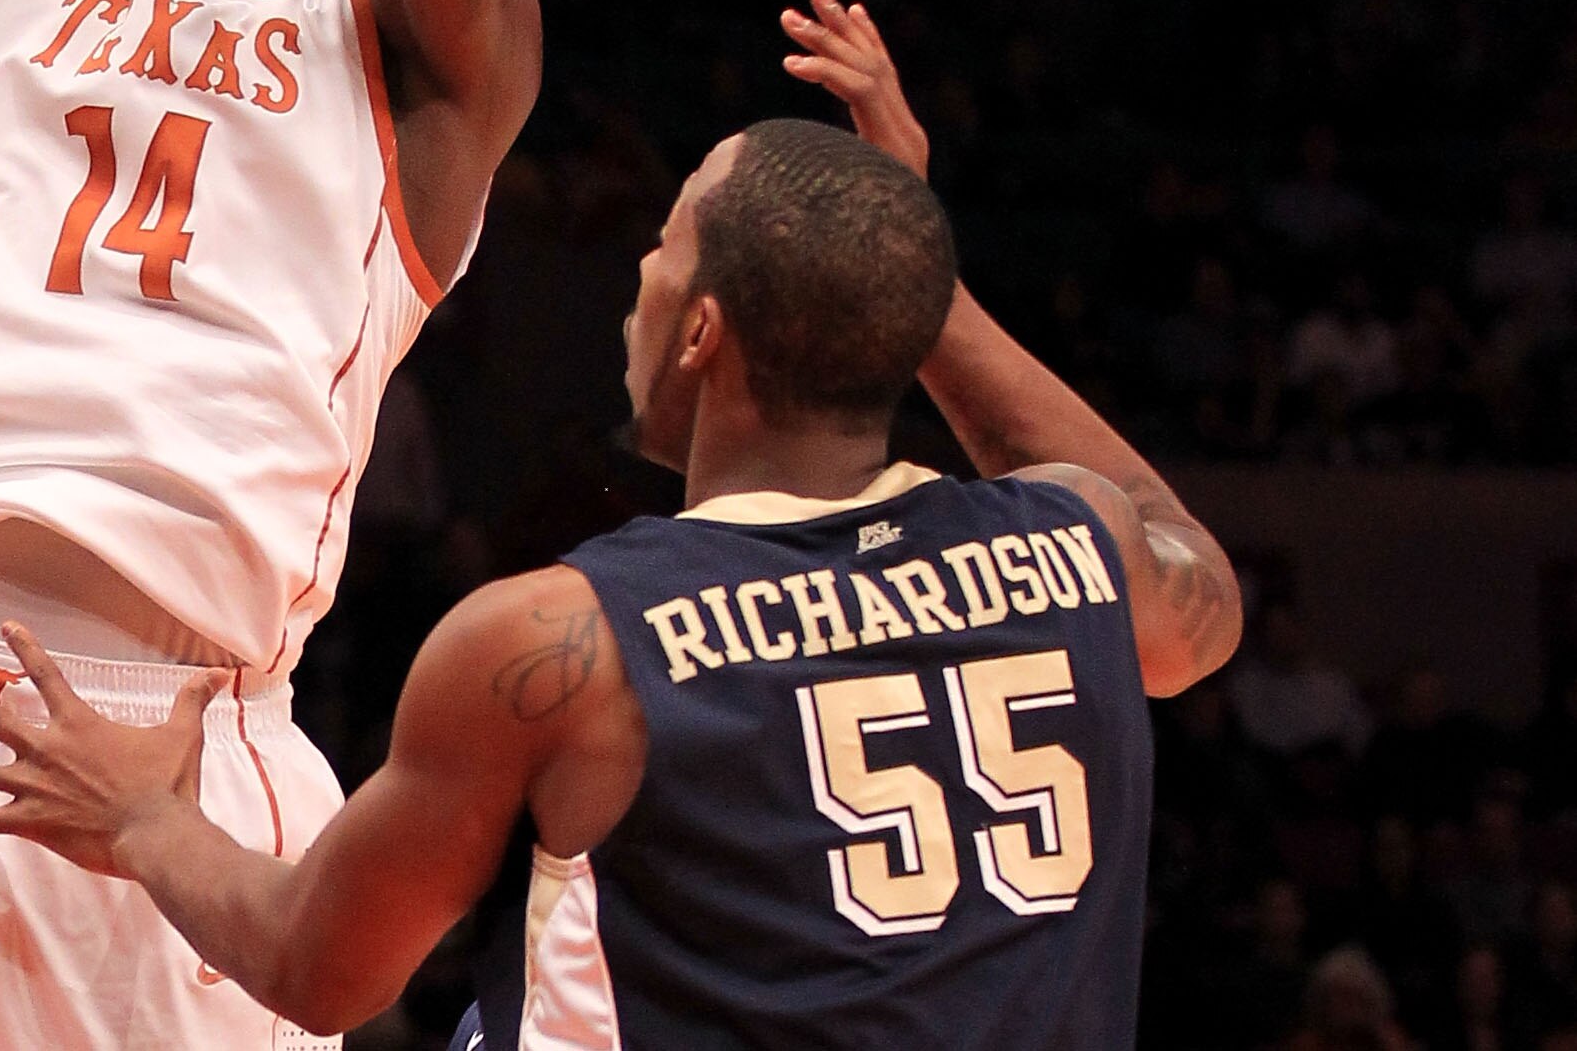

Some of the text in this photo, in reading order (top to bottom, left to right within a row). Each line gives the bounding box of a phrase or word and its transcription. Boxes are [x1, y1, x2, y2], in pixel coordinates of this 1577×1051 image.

[45, 105, 213, 301] 14
[643, 524, 1118, 684] RICHARDSON
[795, 649, 1094, 937] 55
